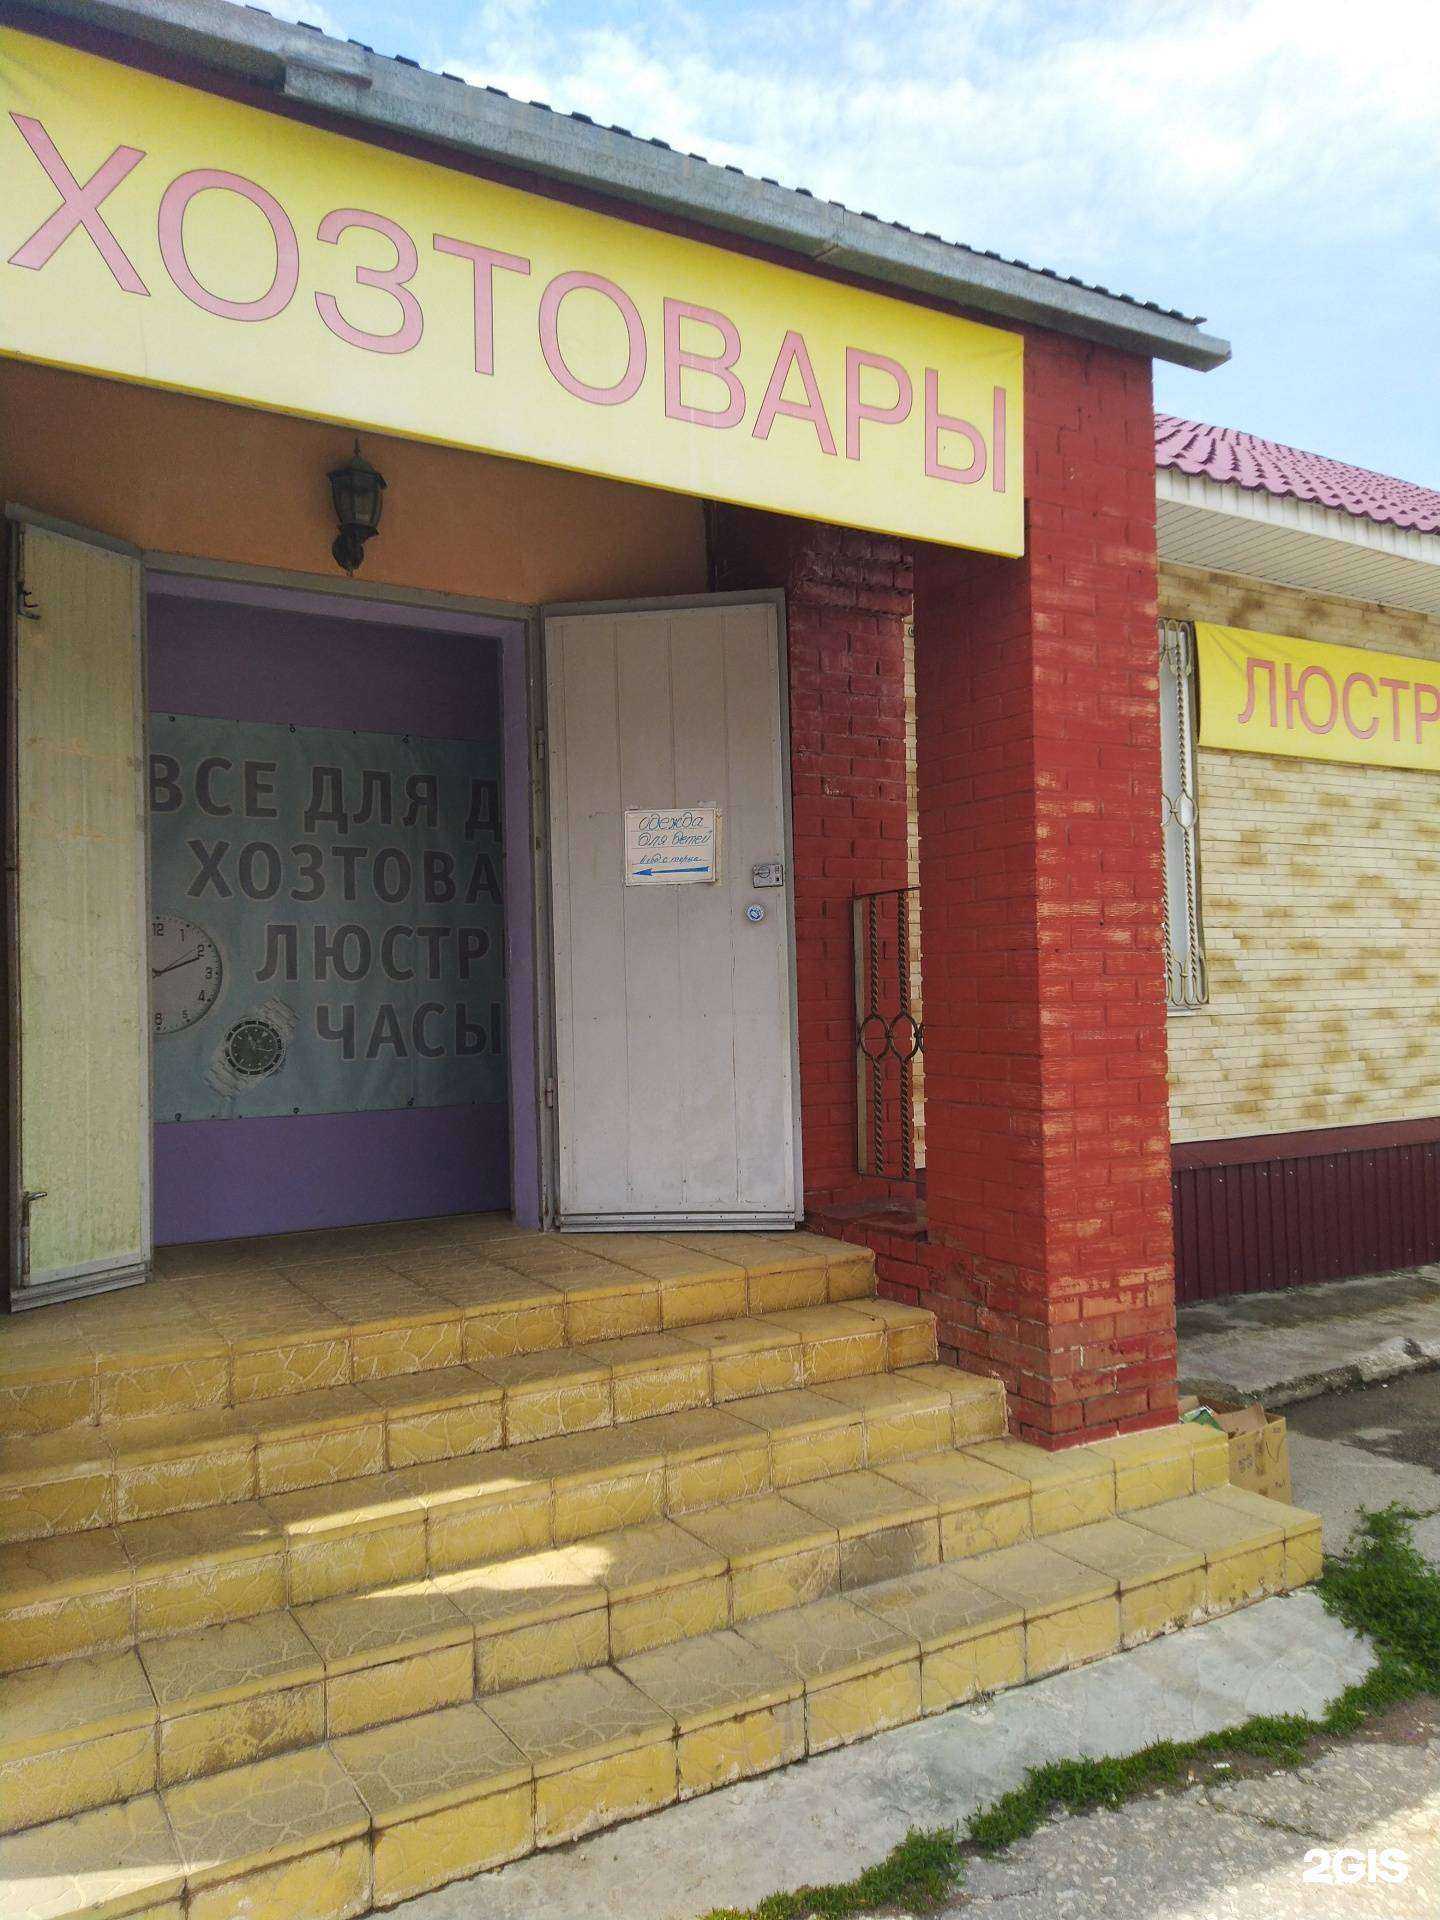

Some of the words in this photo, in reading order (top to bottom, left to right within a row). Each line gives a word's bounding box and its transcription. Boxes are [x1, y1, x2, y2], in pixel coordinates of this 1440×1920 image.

[7, 112, 1006, 493] ХОЗТОВАРЫ
[1238, 657, 1440, 744] ЛЮСТР
[148, 754, 279, 820] ВСЕ
[304, 766, 440, 835] ДЛЯ
[187, 839, 504, 904] ХОЗТОВА
[315, 1003, 503, 1061] ЧАСЫ
